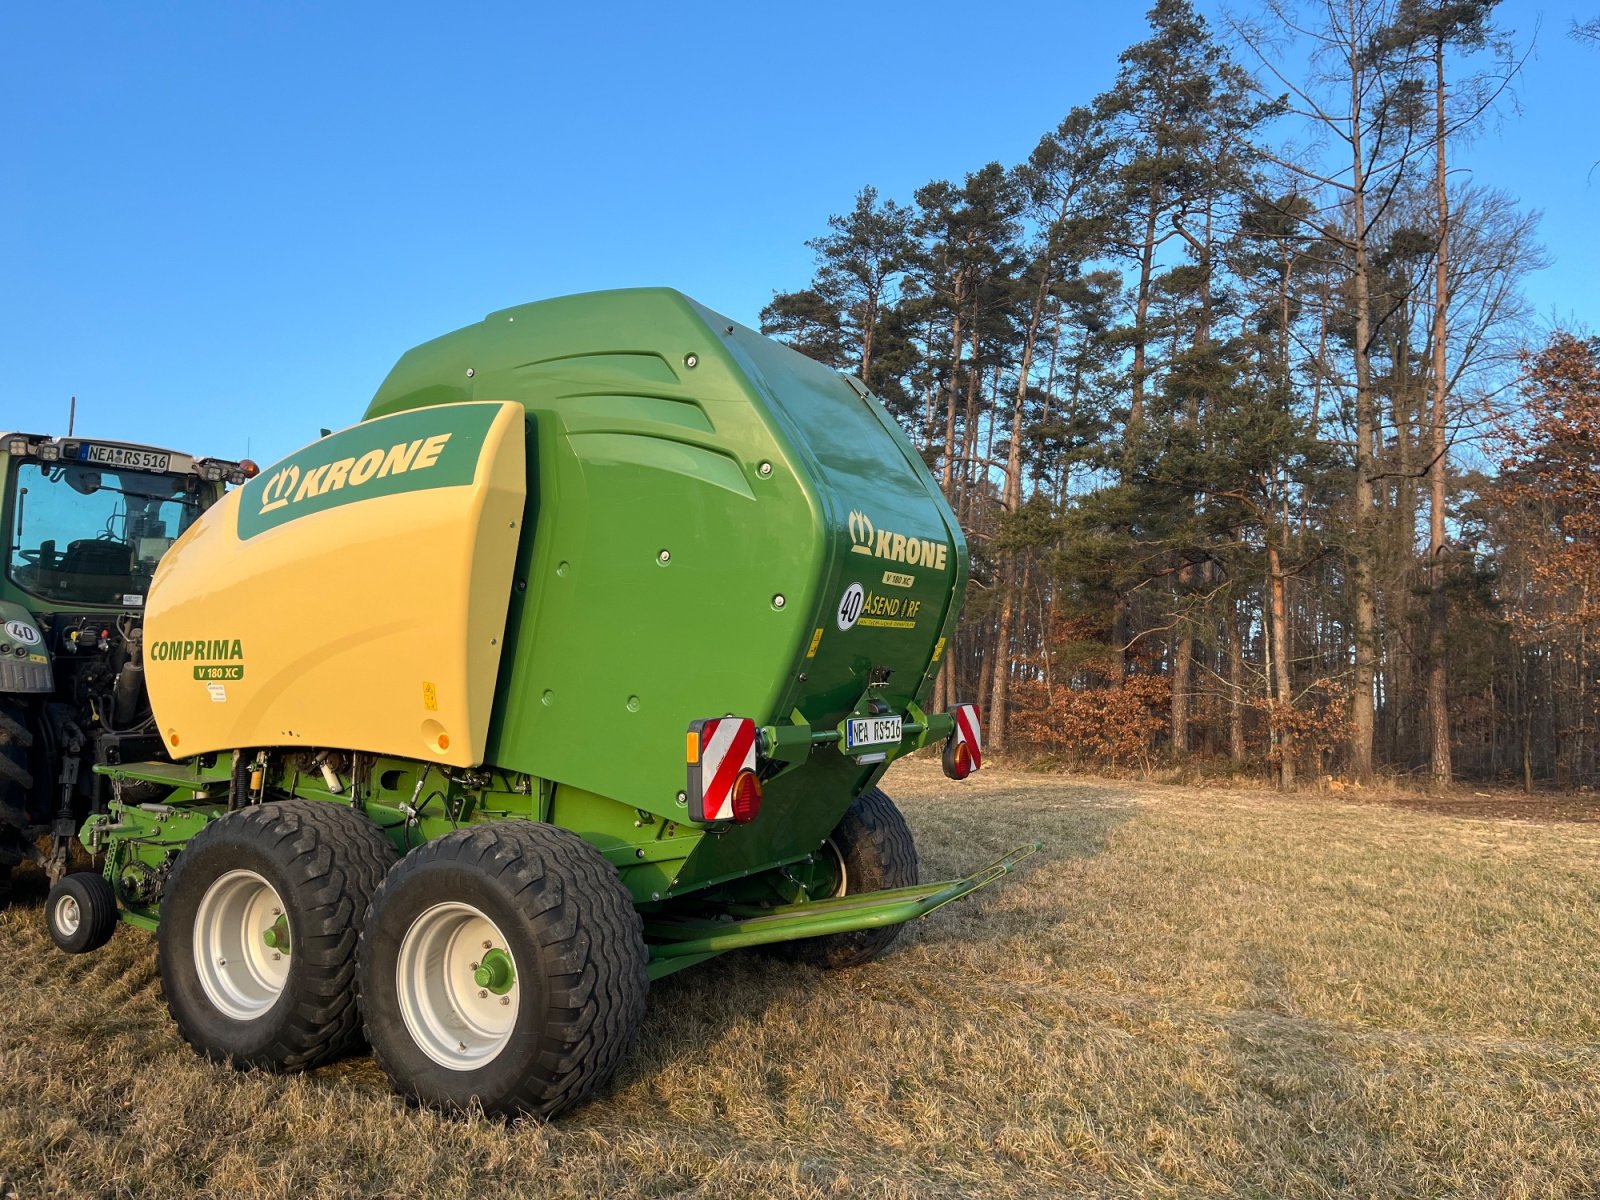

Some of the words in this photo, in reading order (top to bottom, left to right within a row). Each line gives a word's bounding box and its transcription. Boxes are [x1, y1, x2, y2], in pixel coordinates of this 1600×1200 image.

[88, 446, 114, 462] NEA
[123, 451, 141, 466] RS
[143, 453, 166, 469] 516
[293, 432, 452, 503] KRONE
[875, 529, 947, 571] KRONE
[893, 575, 902, 584] 180
[902, 576, 912, 586] XC
[840, 590, 862, 622] 40
[13, 624, 34, 640] 40
[151, 639, 243, 661] COMPRIMA
[198, 668, 205, 678] V
[207, 668, 223, 678] 180
[225, 667, 239, 678] XC
[854, 722, 869, 743] NEA
